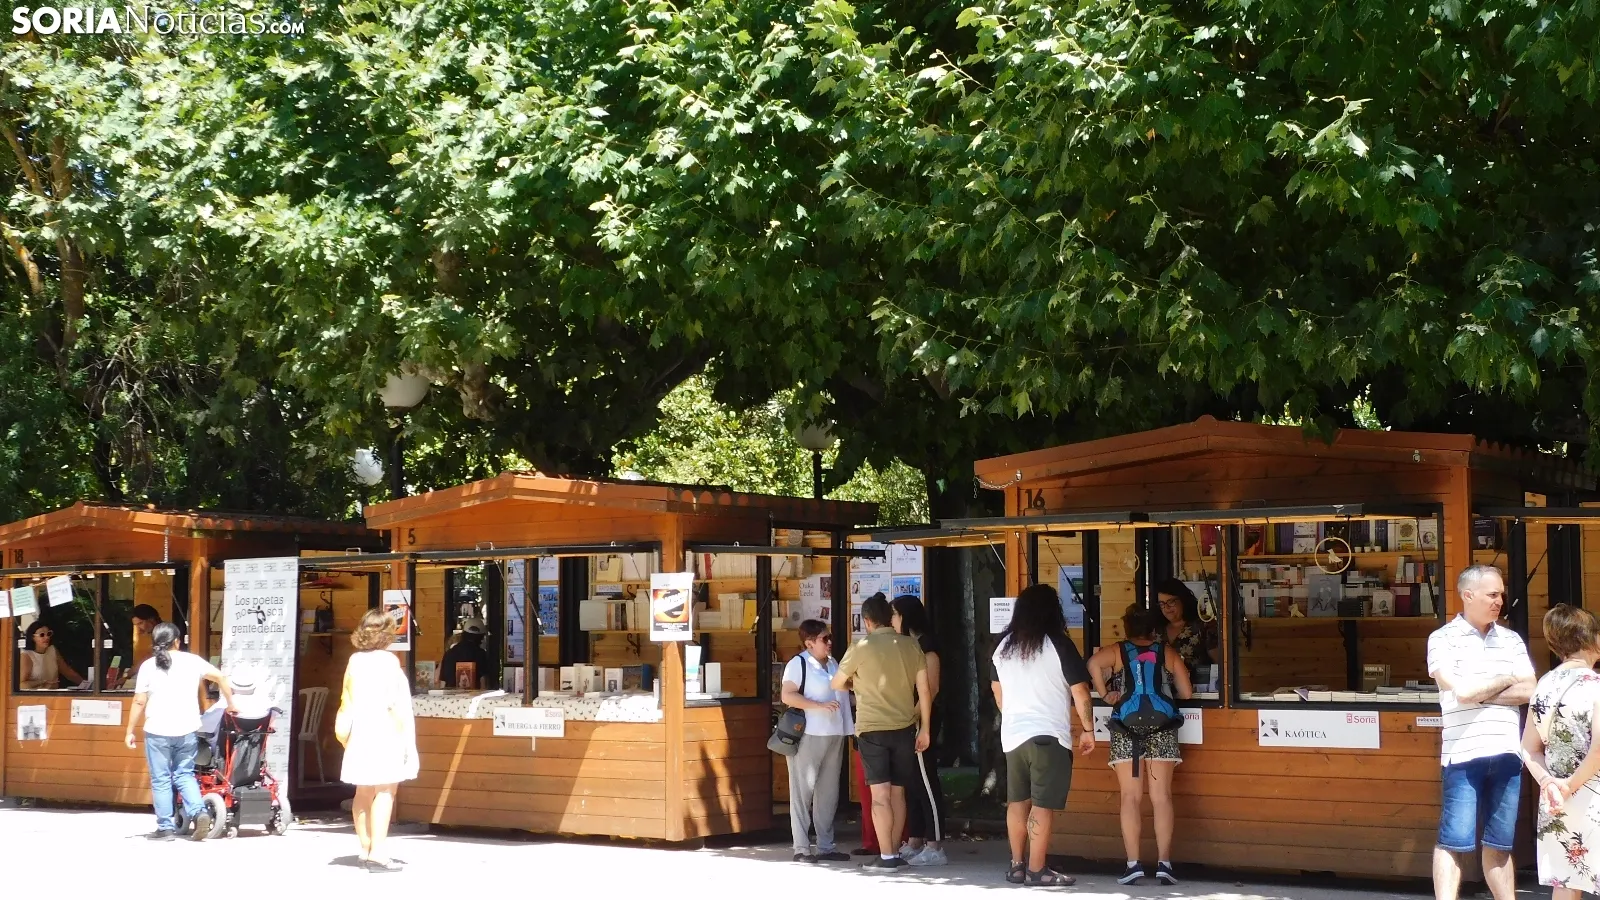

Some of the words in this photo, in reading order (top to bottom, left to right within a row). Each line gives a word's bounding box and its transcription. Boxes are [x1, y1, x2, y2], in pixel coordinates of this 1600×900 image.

[1025, 488, 1045, 509] 16
[408, 528, 416, 545] 5
[14, 549, 24, 563] 18
[235, 595, 250, 605] Los
[252, 597, 284, 608] poetas
[235, 608, 246, 620] no
[267, 608, 283, 616] son
[232, 624, 257, 636] gente
[257, 623, 270, 633] de
[270, 622, 286, 633] fiar
[1184, 712, 1200, 720] oria
[1354, 715, 1377, 724] Soria
[508, 722, 532, 730] HUERGA
[1284, 728, 1327, 739] KAÓTICA
